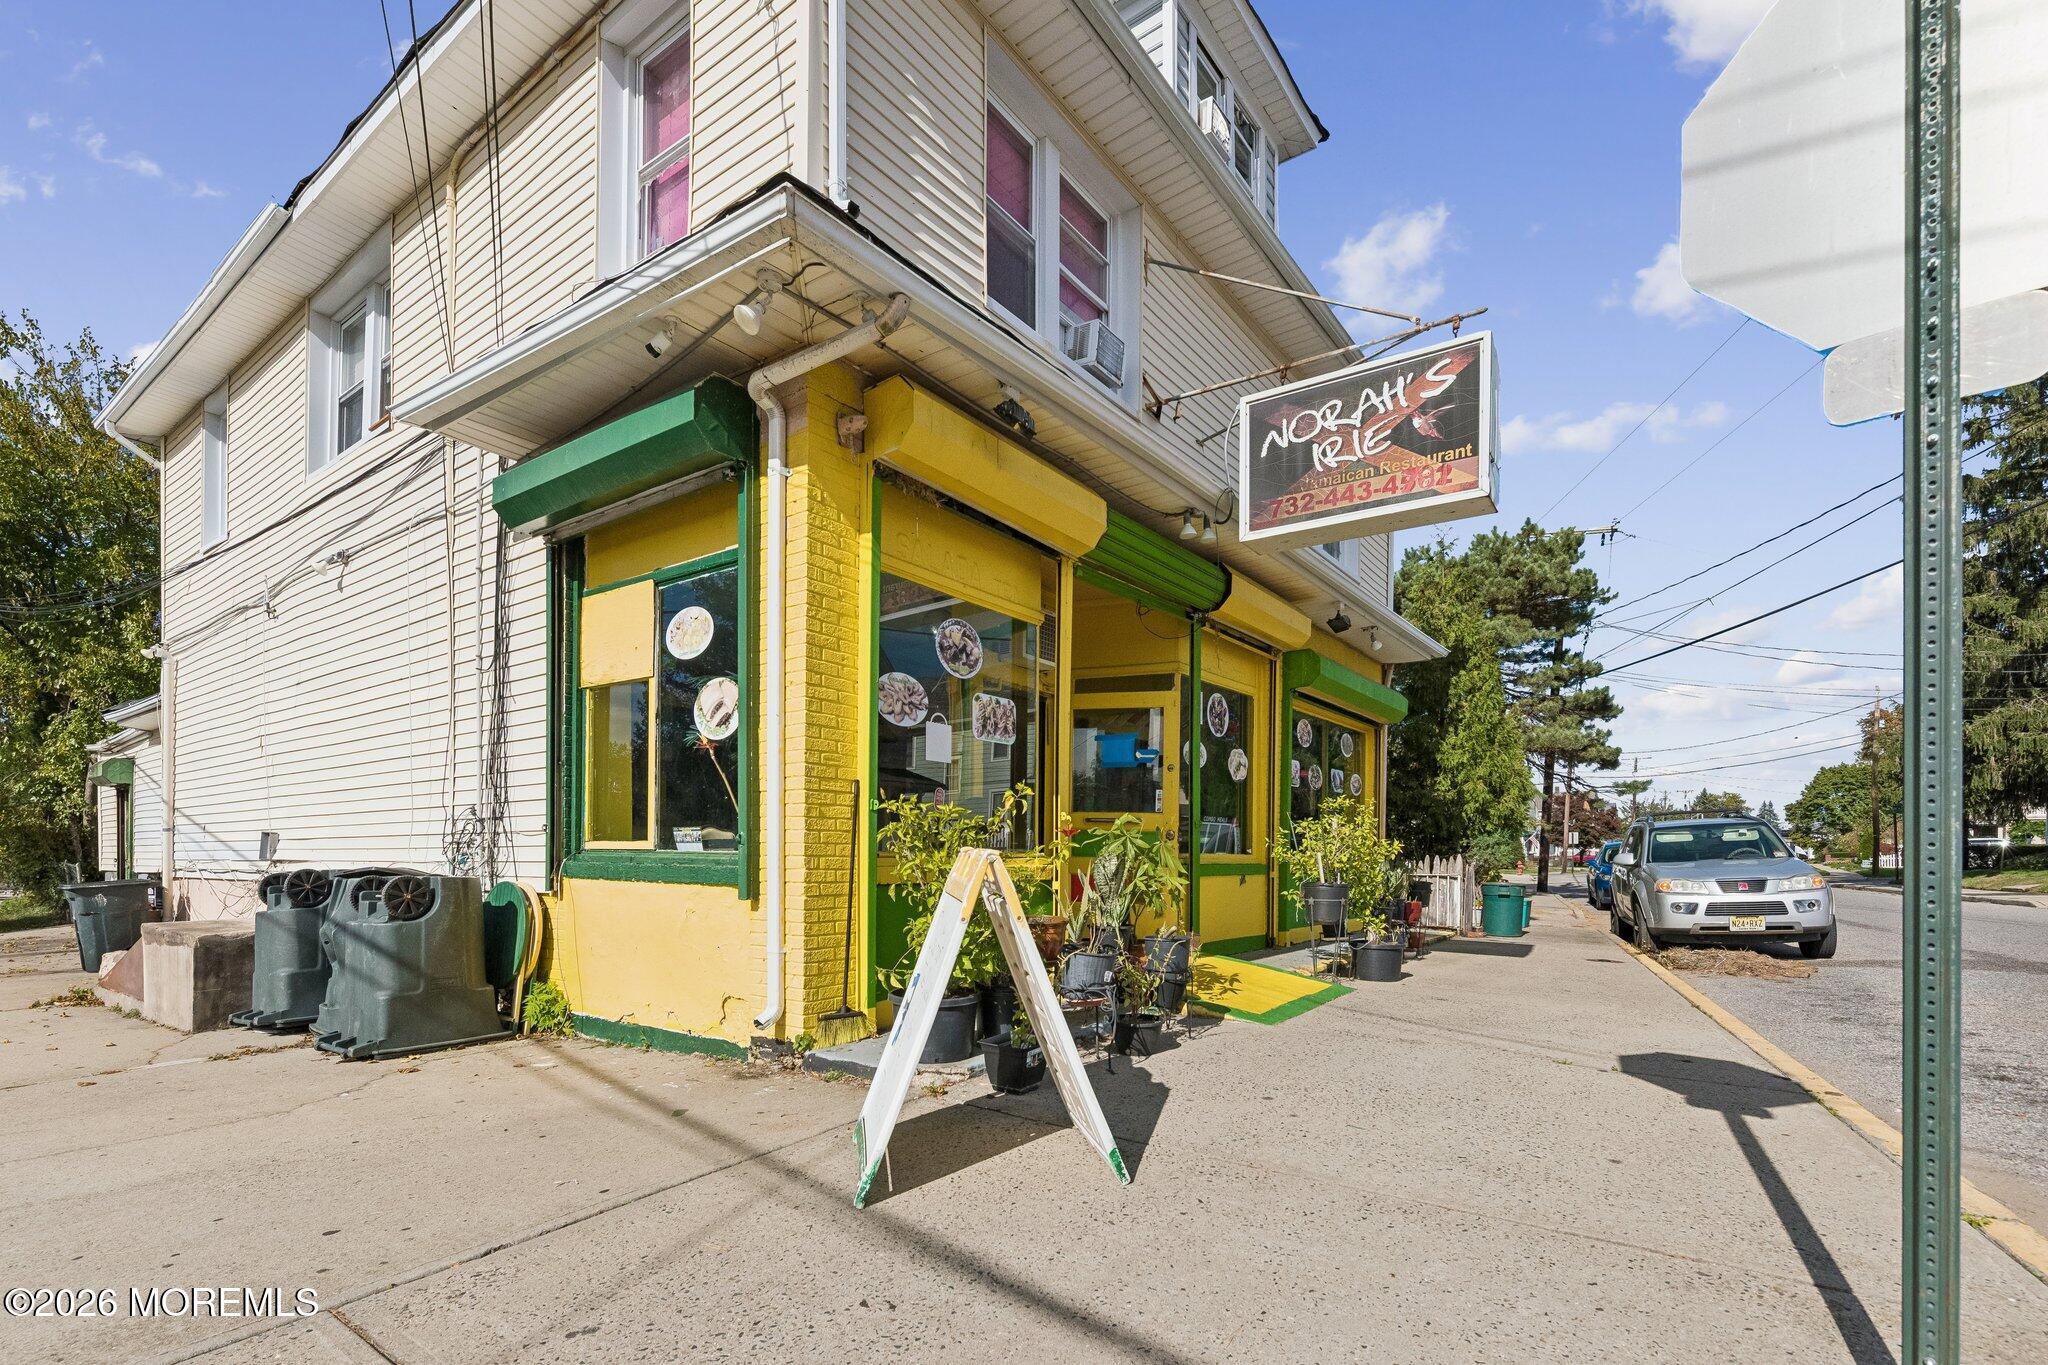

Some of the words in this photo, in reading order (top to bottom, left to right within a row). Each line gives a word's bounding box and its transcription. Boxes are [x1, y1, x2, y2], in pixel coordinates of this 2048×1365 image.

[1260, 357, 1457, 458] NORAH'S
[1311, 414, 1399, 472] IRIE
[1380, 443, 1473, 475] Restaurant
